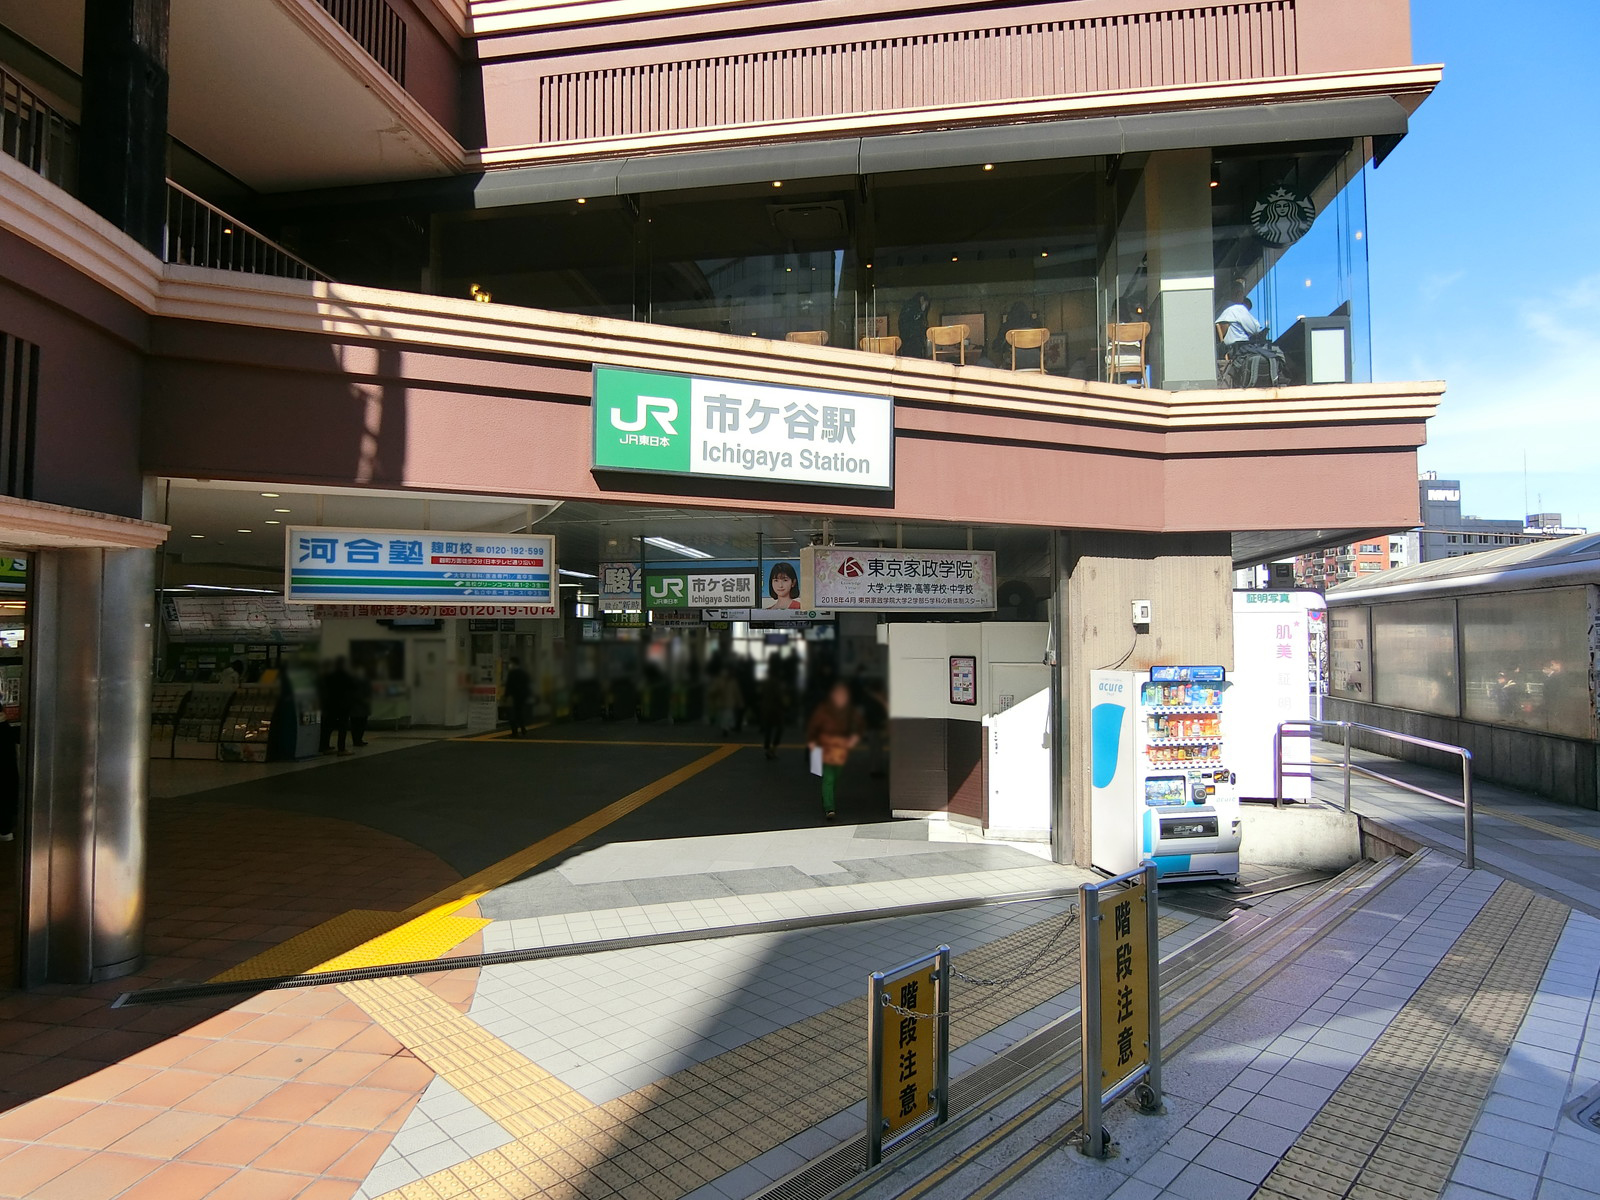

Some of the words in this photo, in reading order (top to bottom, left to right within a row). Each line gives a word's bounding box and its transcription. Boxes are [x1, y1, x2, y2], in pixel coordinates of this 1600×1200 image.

[610, 395, 678, 435] JR
[619, 434, 670, 447] JR東日本
[702, 440, 793, 471] Ichigaya
[799, 449, 870, 474] Station
[299, 538, 424, 565] 河合塾
[867, 559, 973, 579] 東京家政学院
[650, 578, 683, 598] JR
[692, 594, 722, 604] Ichigaya
[724, 595, 750, 603] Station
[821, 596, 857, 604] 2018年4月
[1246, 593, 1290, 604] 証明写真
[1098, 682, 1124, 692] acure
[1115, 900, 1133, 1068] 階段注意
[899, 980, 919, 1119] 階段注意
